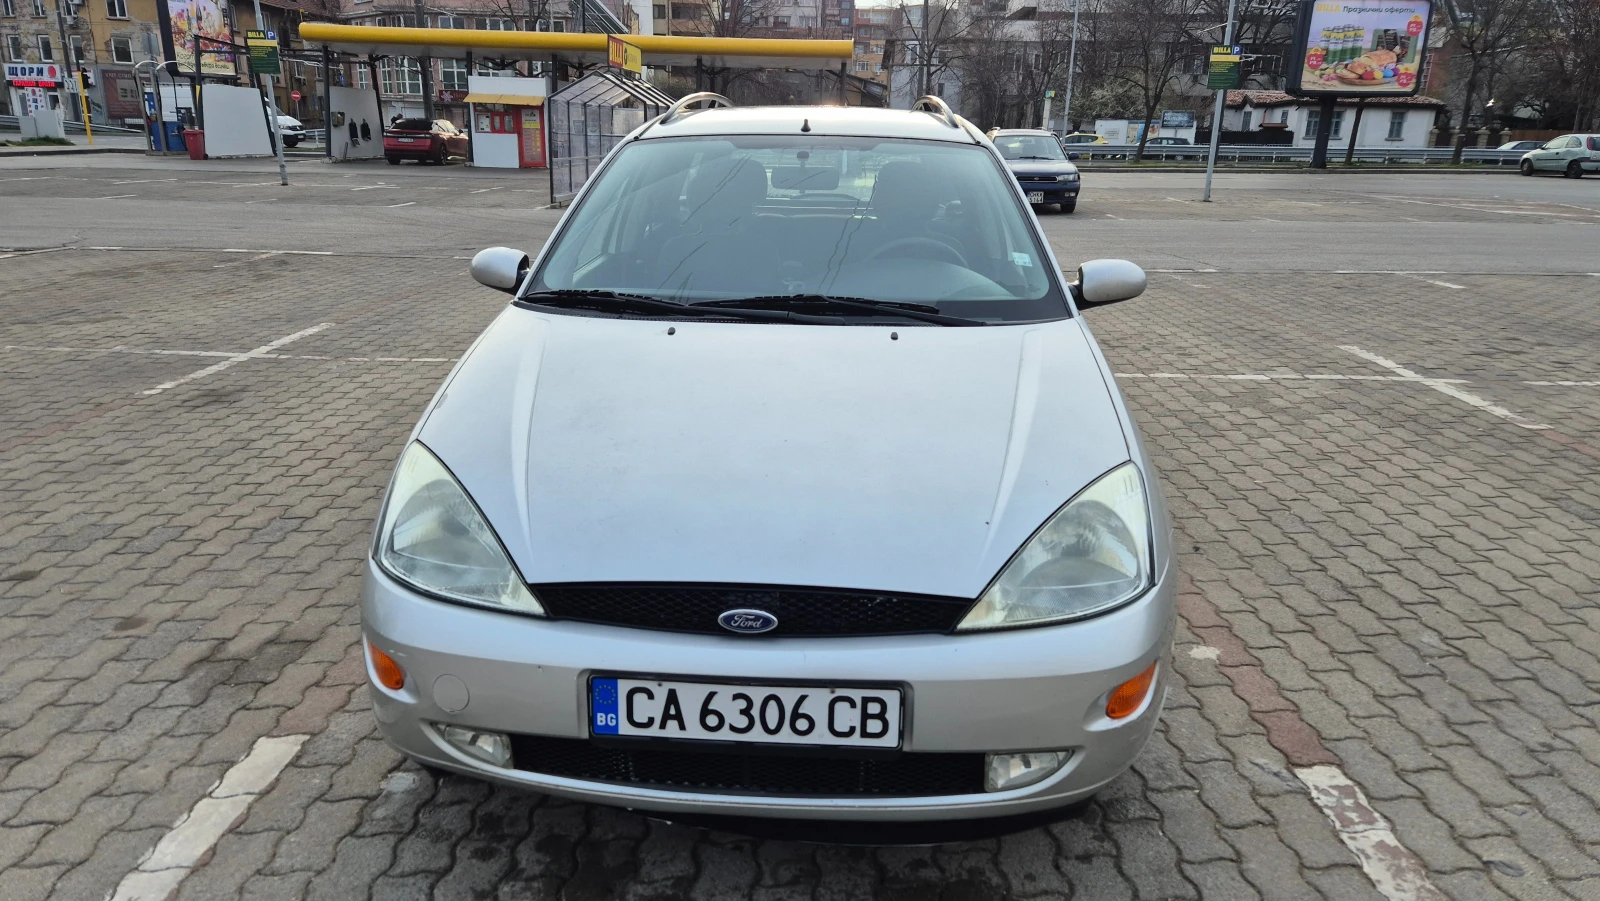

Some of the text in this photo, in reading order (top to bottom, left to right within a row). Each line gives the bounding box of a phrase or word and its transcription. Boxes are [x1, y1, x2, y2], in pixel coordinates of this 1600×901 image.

[1316, 4, 1340, 12] BILLA
[1342, 5, 1416, 14] Празнични оферти
[267, 31, 274, 39] P
[1233, 46, 1240, 54] P
[8, 66, 44, 77] ЩОРИ
[730, 613, 764, 628] Ford
[625, 686, 890, 739] CA 6306 CB
[596, 712, 617, 726] BG
